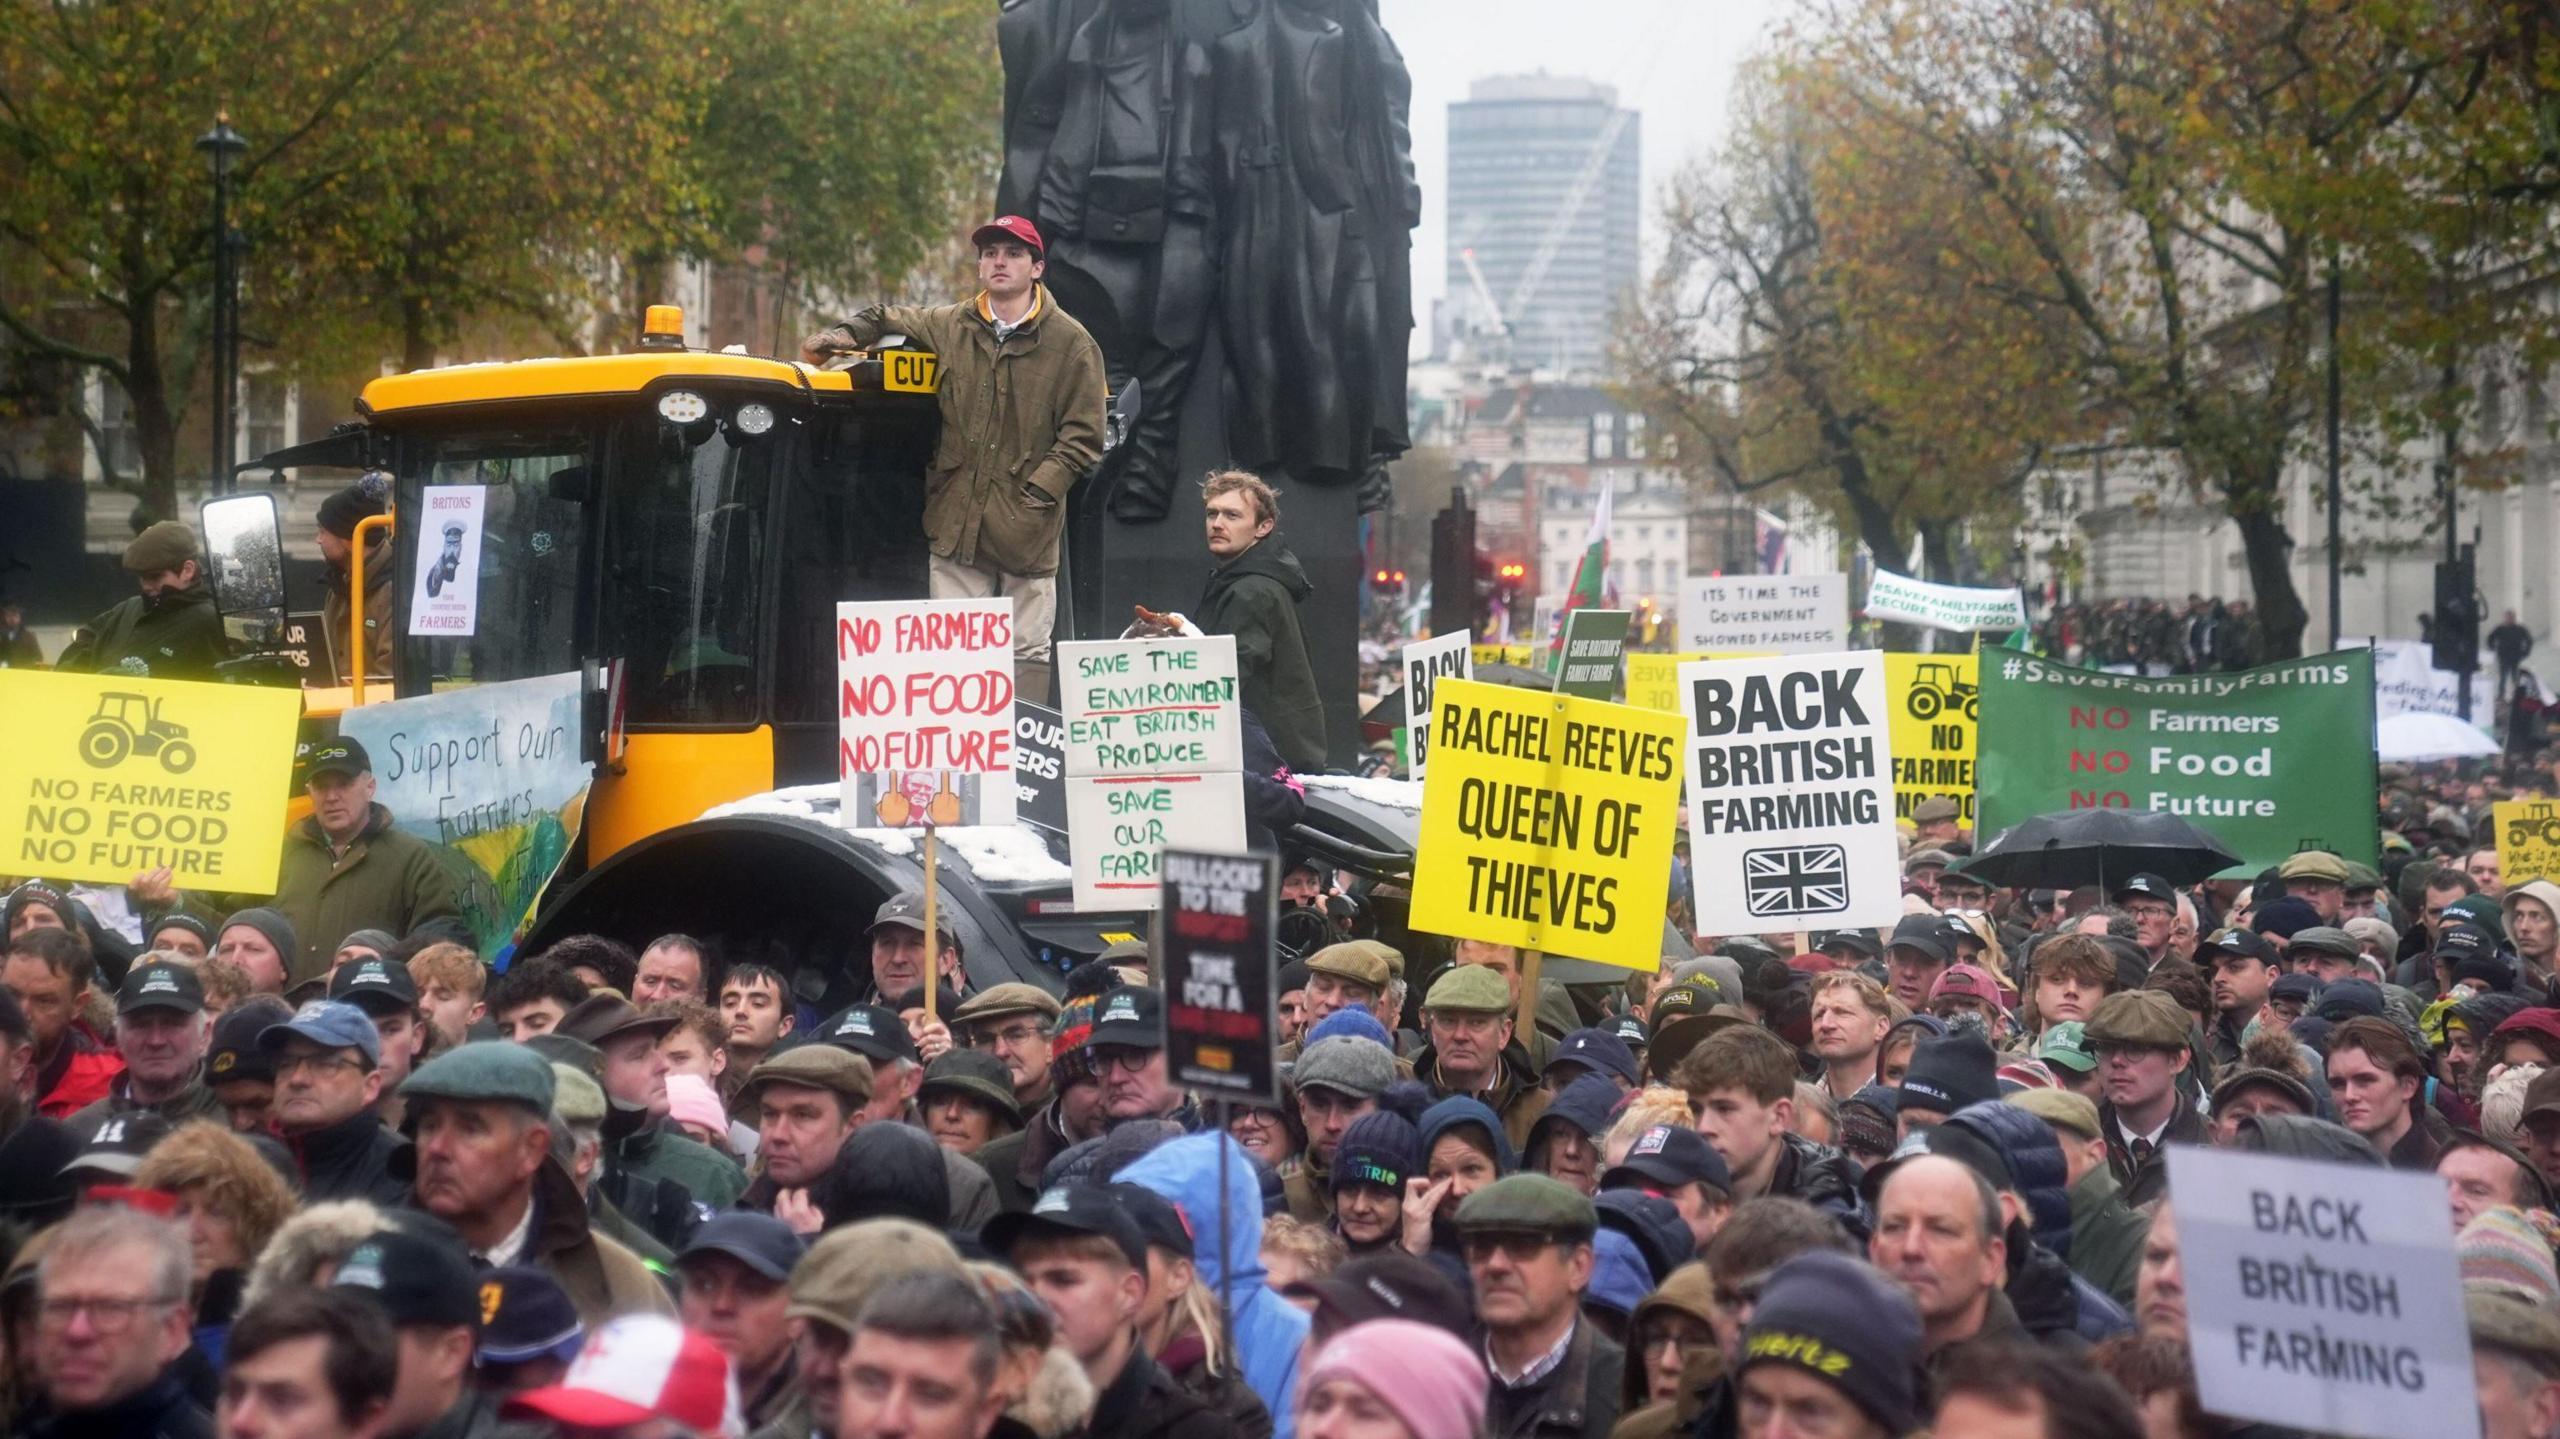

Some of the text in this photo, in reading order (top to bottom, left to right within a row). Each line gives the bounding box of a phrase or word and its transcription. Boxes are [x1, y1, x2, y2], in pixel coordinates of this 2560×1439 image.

[895, 356, 938, 387] CU7
[432, 496, 471, 510] BRITONS
[1702, 585, 1821, 602] ITS TIME THE
[419, 615, 466, 629] FARMERS
[1873, 595, 2016, 626] SECURE YOUR FOOD
[287, 625, 306, 643] UR
[839, 612, 1011, 661] NO FARMERS
[1569, 639, 1621, 657] SAVE BRITAIN'S
[1694, 630, 1834, 647] SHOWED FARMERS
[1078, 650, 1197, 678] SAVE THE
[1566, 664, 1614, 683] FAMILY FARMS
[2002, 657, 2350, 697] #SaveFamilyFarms
[842, 670, 1013, 718] NO FOOD
[1087, 676, 1236, 709] ENVIRONMENT
[1693, 667, 1870, 737] BACK
[1016, 717, 1065, 752] OUR
[1070, 711, 1215, 743] EAT BRITISH
[2070, 706, 2280, 734] NO Farmers
[840, 726, 1010, 780] NO FUTURE
[1440, 703, 1551, 763] RACHEL
[1562, 721, 1674, 782] REEVES
[1932, 724, 1963, 751] NO
[388, 719, 503, 794] Support
[1016, 746, 1061, 781] ERS
[1096, 742, 1207, 769] PRODUCE
[1699, 736, 1876, 789] BRITISH
[1891, 757, 1977, 786] FARME
[2070, 747, 2272, 777] NO Food
[30, 778, 232, 812] NO FARMERS
[1107, 789, 1173, 815] SAVE
[2070, 790, 2276, 817] NO Future
[25, 805, 228, 845] NO FOOD
[1458, 777, 1642, 859] QUEEN OF
[1702, 788, 1880, 835] FARMING
[1114, 819, 1167, 846] OUR
[20, 837, 223, 875] NO FUTURE
[1100, 851, 1159, 878] FAR
[1467, 856, 1618, 934] THIEVES
[2252, 1190, 2368, 1245] BACK
[2239, 1256, 2401, 1319] BRITISH
[2234, 1323, 2424, 1391] FARMING
